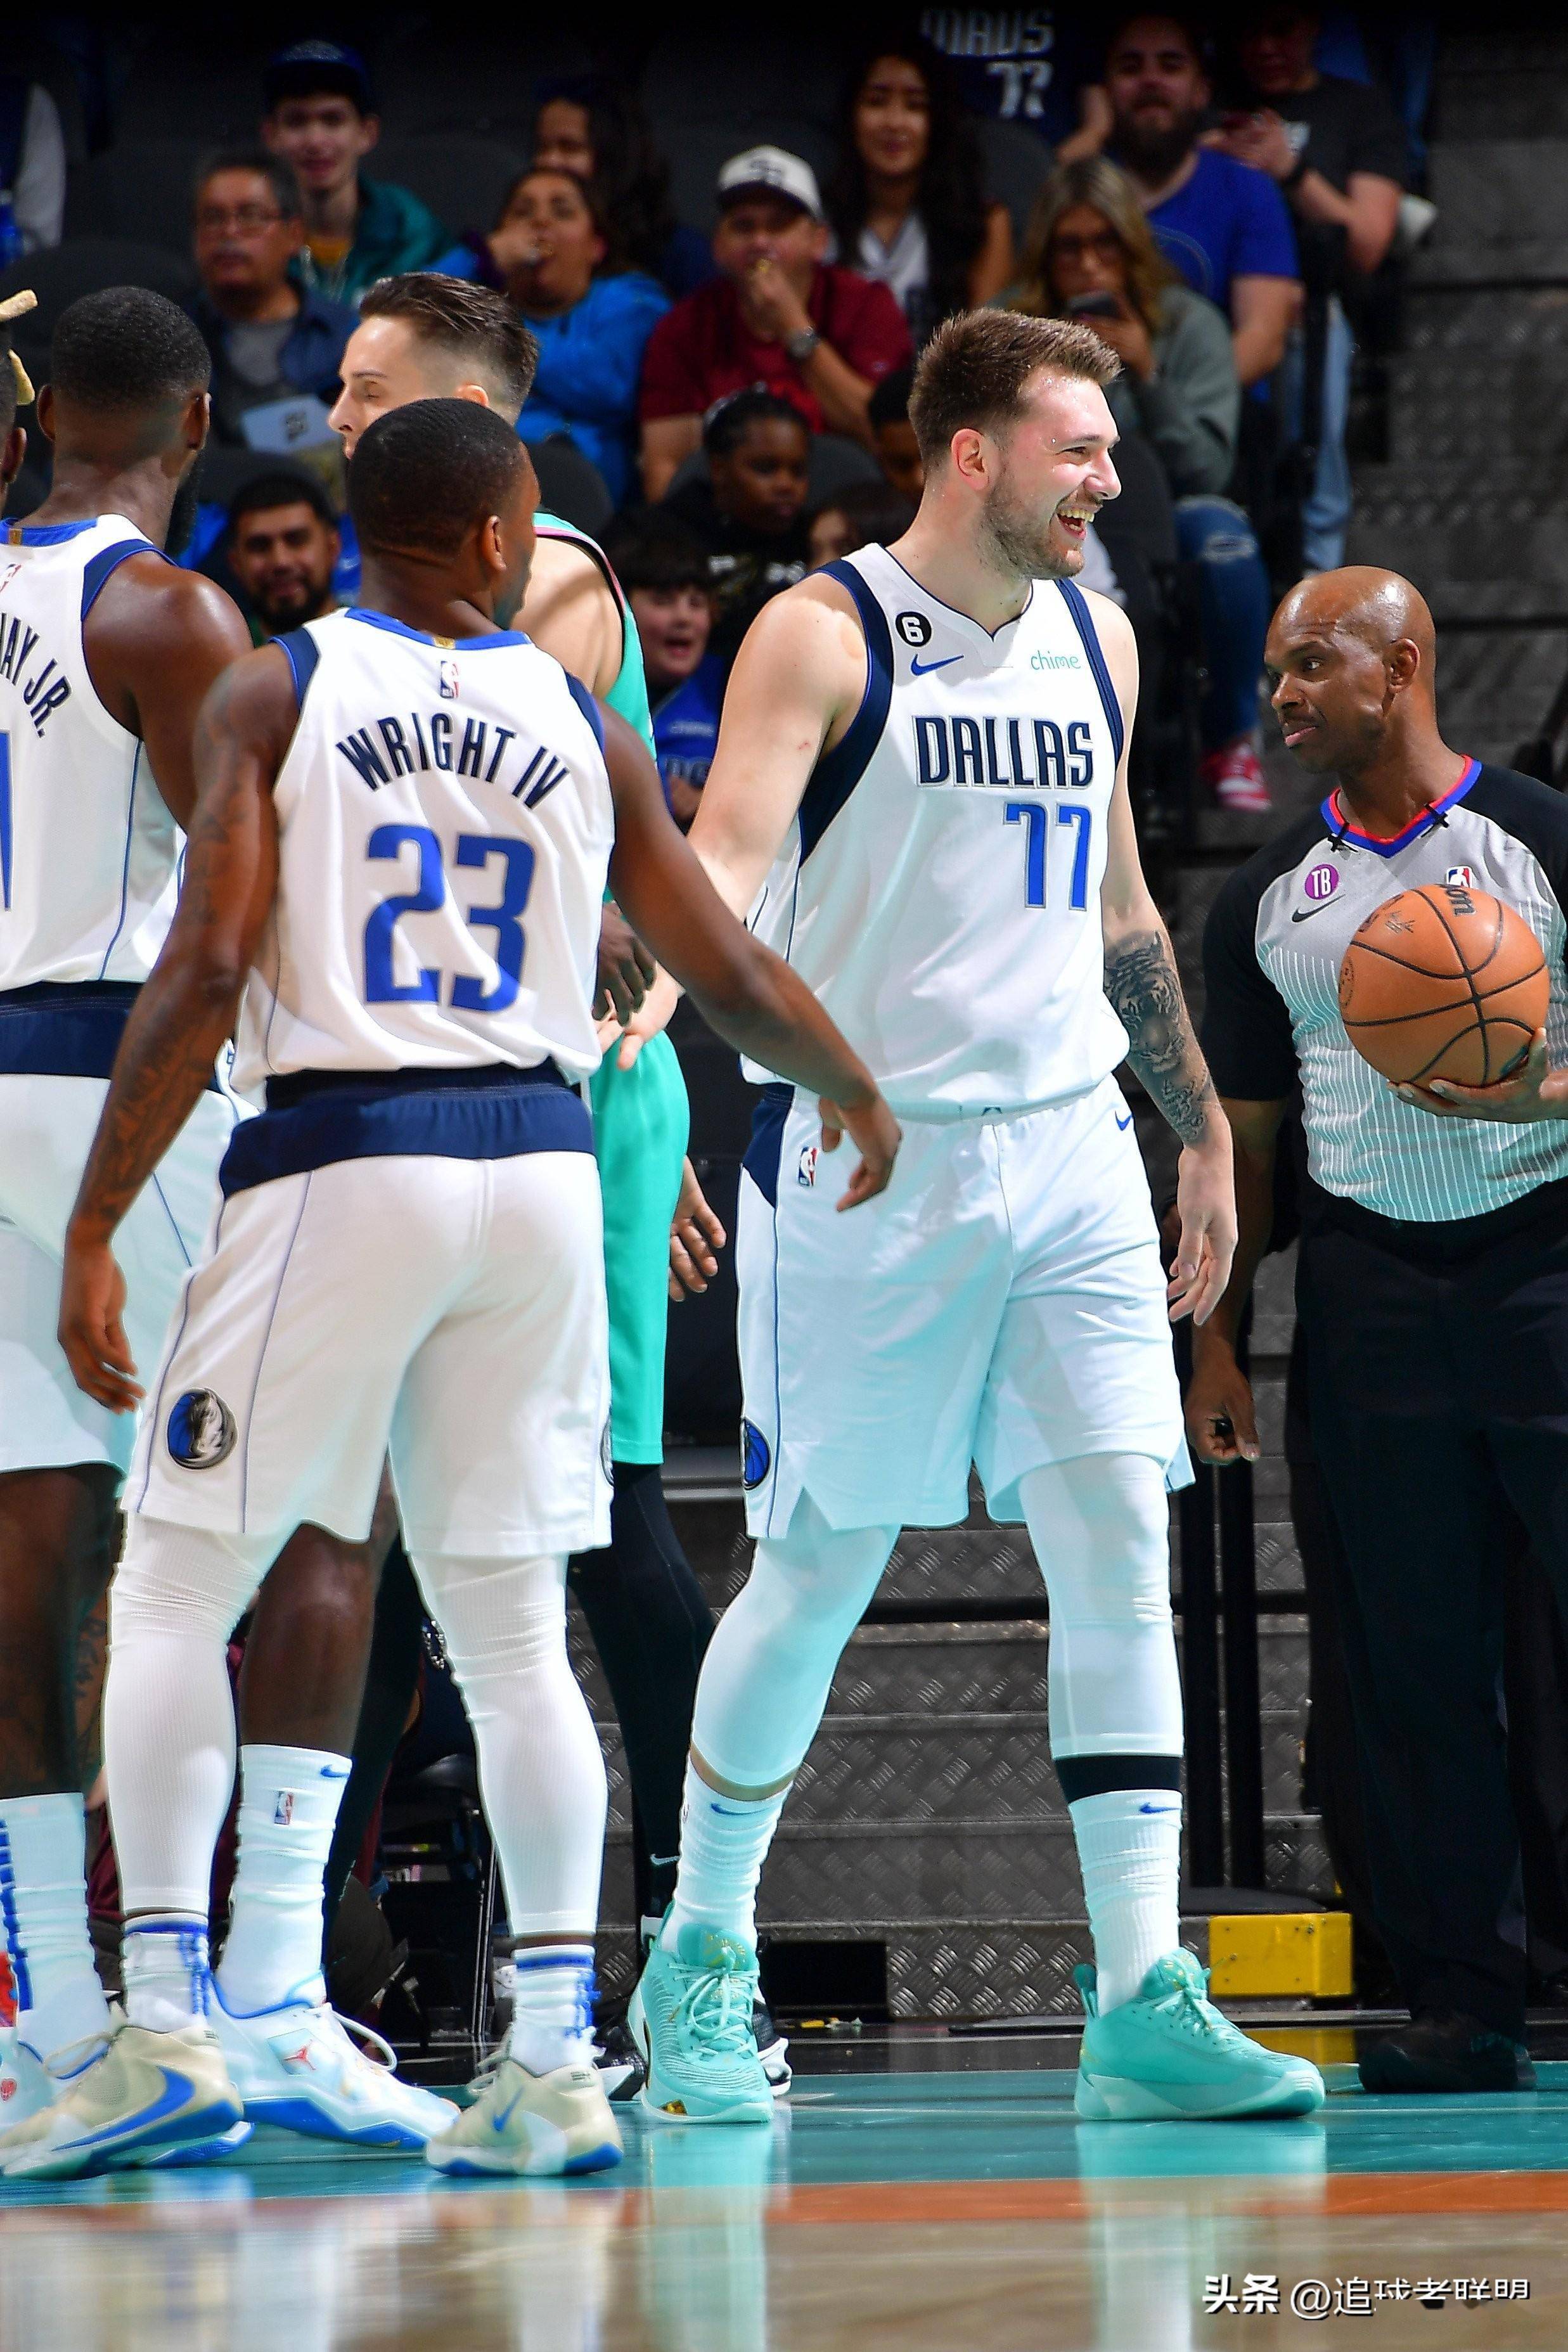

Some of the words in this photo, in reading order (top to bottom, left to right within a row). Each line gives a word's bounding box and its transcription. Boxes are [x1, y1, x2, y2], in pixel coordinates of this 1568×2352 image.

[902, 617, 923, 641] 6
[1030, 650, 1081, 671] chime
[0, 612, 39, 686] AY
[23, 658, 73, 739] JR.
[335, 712, 517, 792] WRIGHT
[511, 745, 571, 809] IV
[911, 715, 1094, 790] DALLAS
[1003, 802, 1093, 912] 77
[1312, 868, 1332, 898] TB
[363, 823, 536, 1012] 23
